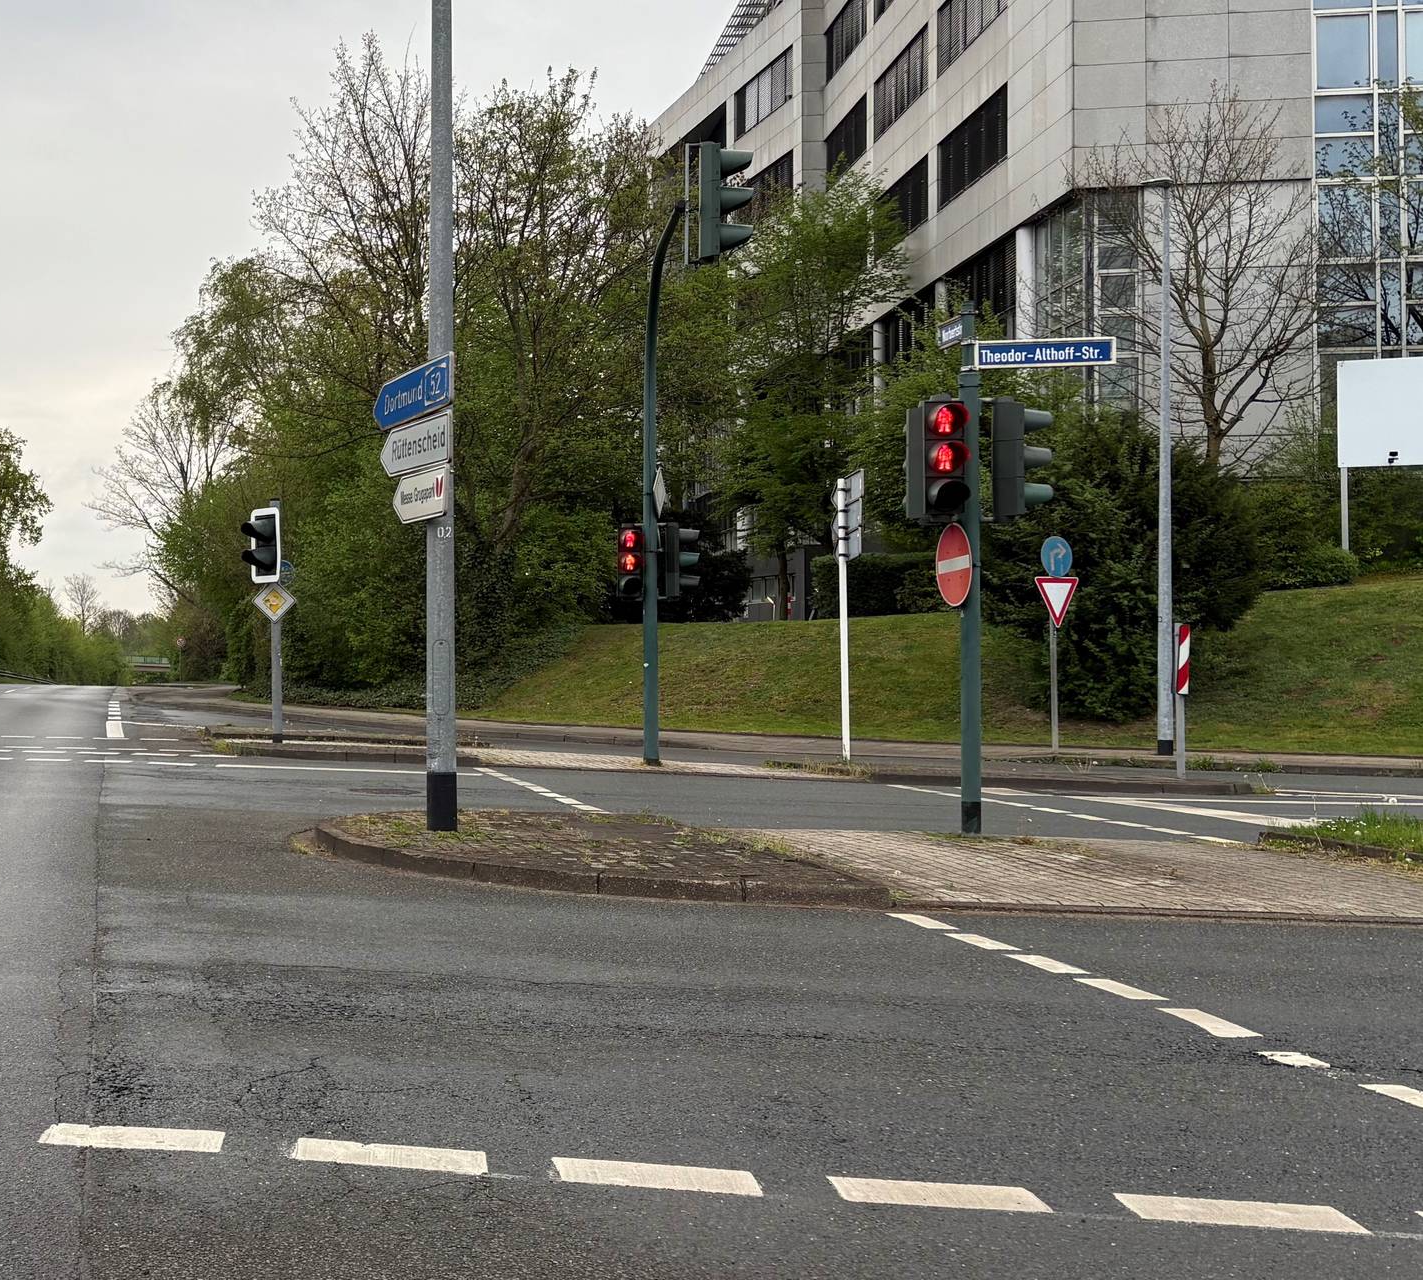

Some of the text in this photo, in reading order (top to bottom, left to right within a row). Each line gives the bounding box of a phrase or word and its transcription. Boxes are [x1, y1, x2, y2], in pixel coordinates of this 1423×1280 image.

[981, 346, 1103, 363] Theodor-Althoff-Str.
[384, 371, 440, 415] Dortmund 52
[392, 424, 445, 461] Rüttenscheid
